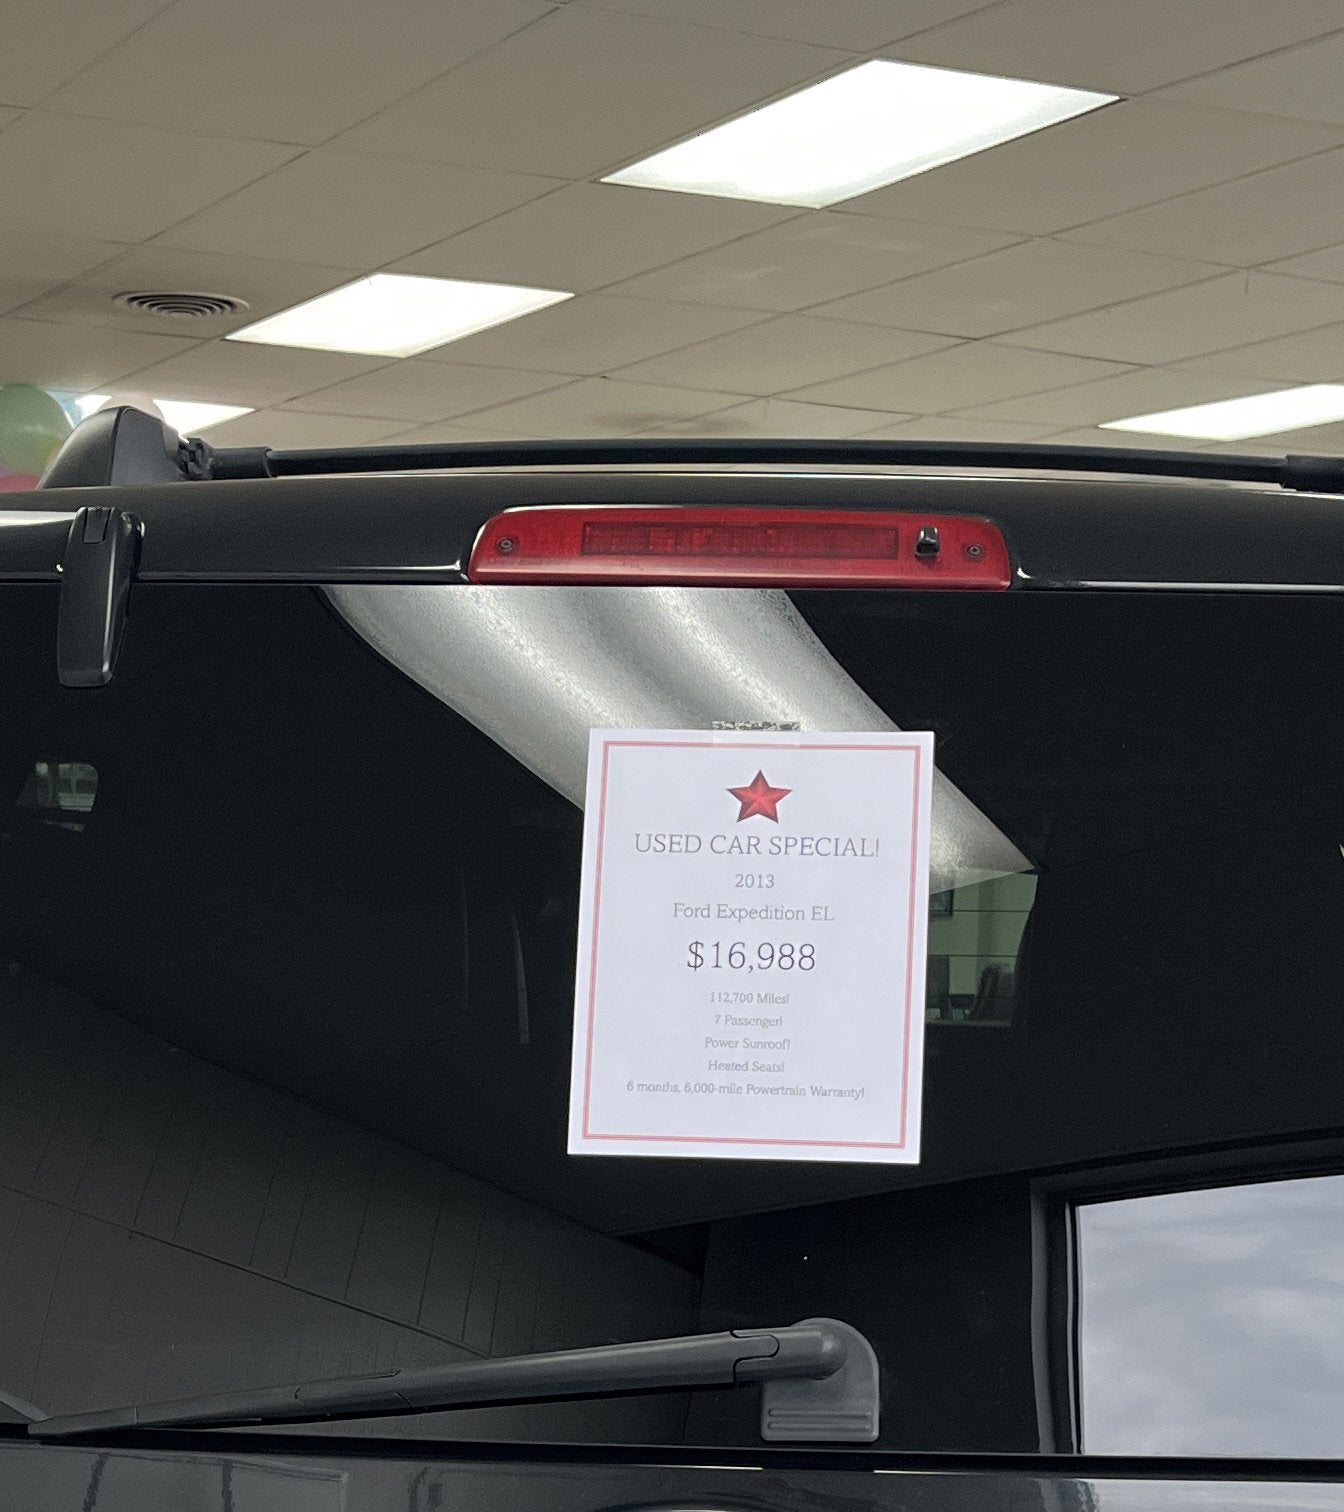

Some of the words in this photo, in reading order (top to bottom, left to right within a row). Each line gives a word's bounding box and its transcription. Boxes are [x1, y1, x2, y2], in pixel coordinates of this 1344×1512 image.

[635, 833, 702, 853] USED
[710, 834, 761, 855] CAR
[768, 836, 880, 857] SPECIAL!
[734, 873, 775, 889] 2013
[673, 902, 711, 919] Ford
[716, 903, 805, 923] Expedition
[810, 905, 835, 921] EL
[687, 940, 816, 973] $16,988
[756, 993, 790, 1005] Miles!
[714, 1014, 722, 1025] 7
[724, 1014, 783, 1029] Passenger!
[704, 1036, 739, 1049] Power
[742, 1037, 791, 1050] Sunroof!
[707, 1060, 749, 1072] Heated
[751, 1061, 785, 1073] Seats!
[626, 1081, 634, 1092] 6
[637, 1081, 681, 1094] months,
[746, 1083, 806, 1097] Powertrain
[809, 1085, 865, 1101] Warranty!
